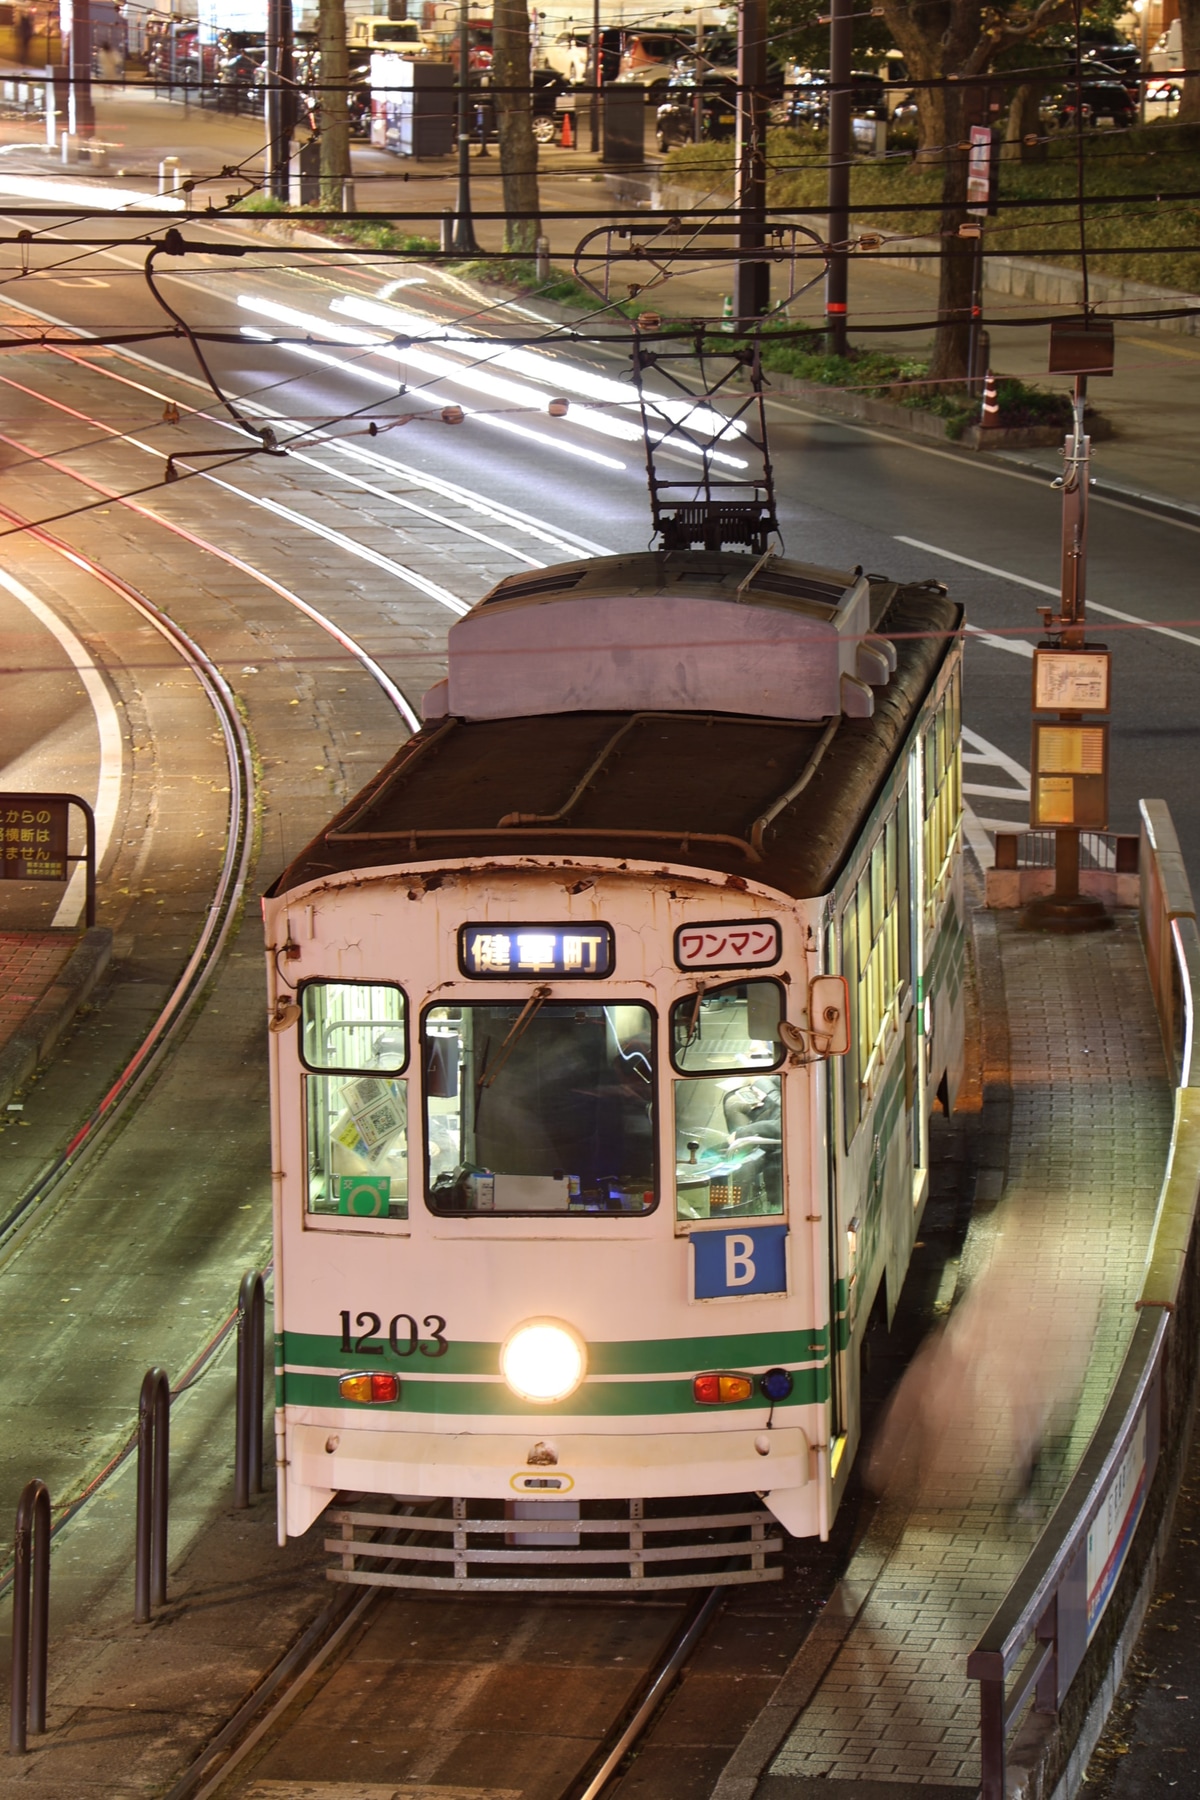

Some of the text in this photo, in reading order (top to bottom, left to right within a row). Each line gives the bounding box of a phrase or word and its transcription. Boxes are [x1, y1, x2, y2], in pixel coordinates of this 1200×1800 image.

[0, 810, 51, 824] からの
[0, 827, 50, 842] 横断は
[0, 847, 50, 860] ません
[471, 934, 602, 972] 健軍町
[682, 931, 773, 959] ワンマン
[725, 1234, 756, 1287] B
[339, 1310, 449, 1357] 1203
